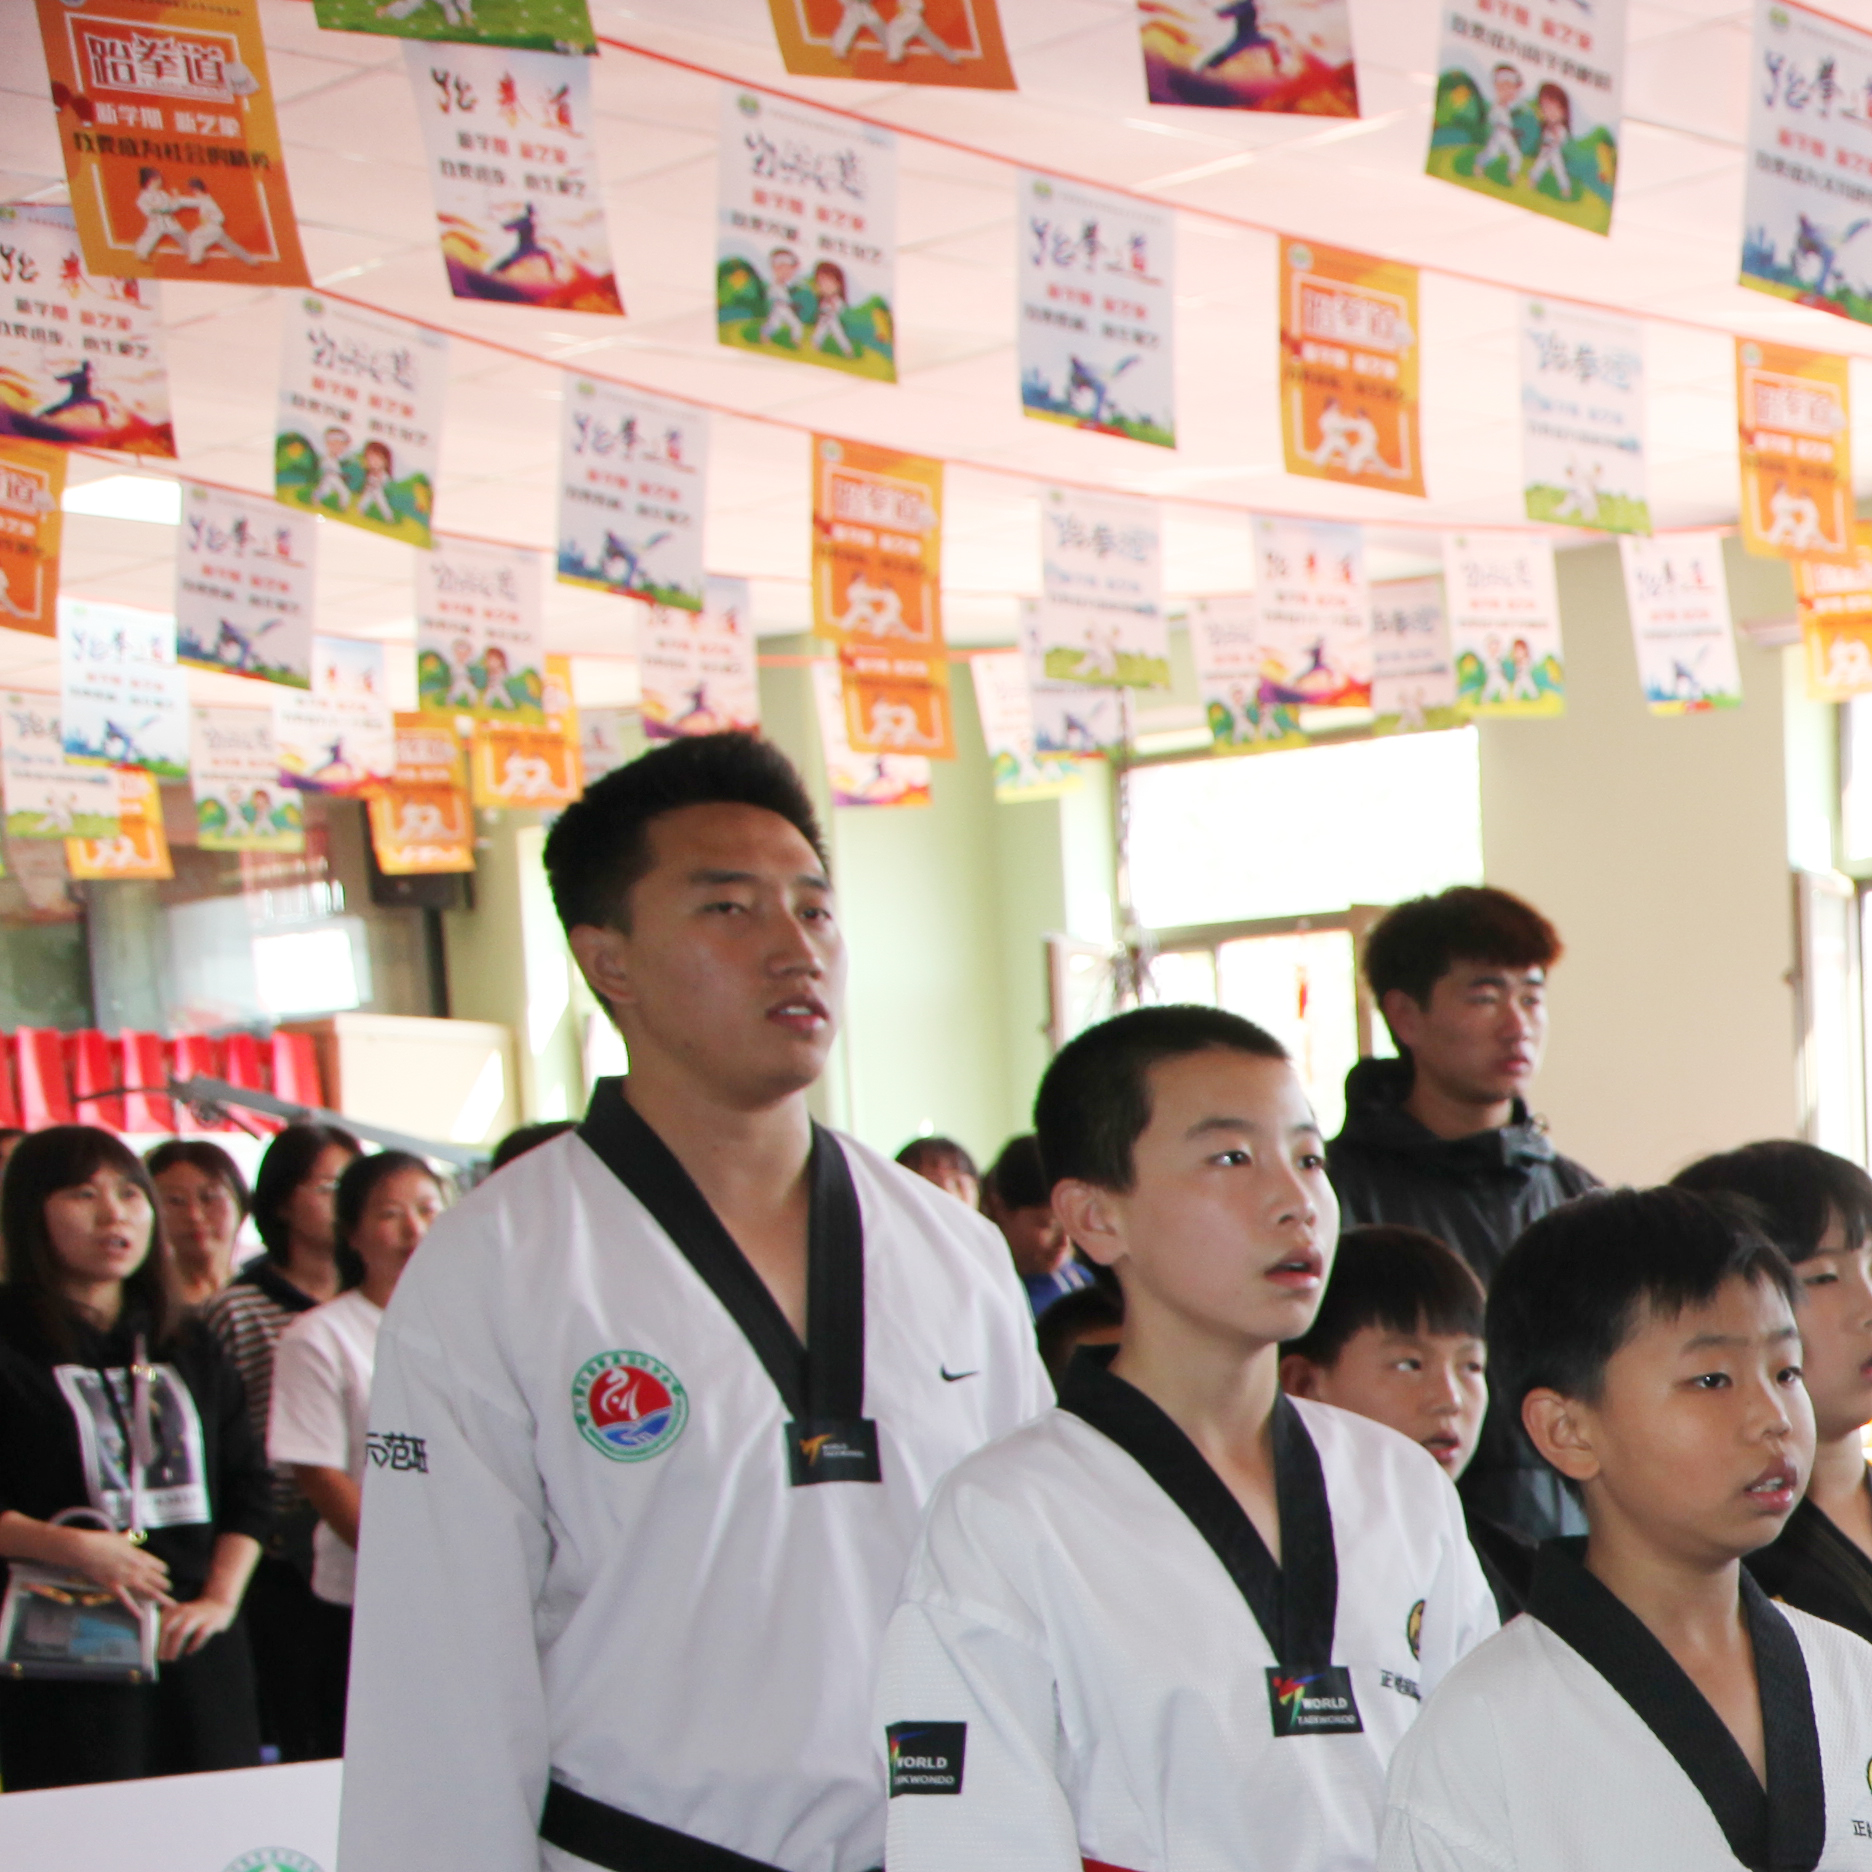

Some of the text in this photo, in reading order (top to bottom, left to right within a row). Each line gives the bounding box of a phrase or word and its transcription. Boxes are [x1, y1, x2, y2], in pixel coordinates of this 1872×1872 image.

[84, 32, 232, 96] 跆拳道
[1302, 1697, 1348, 1710] WORLD
